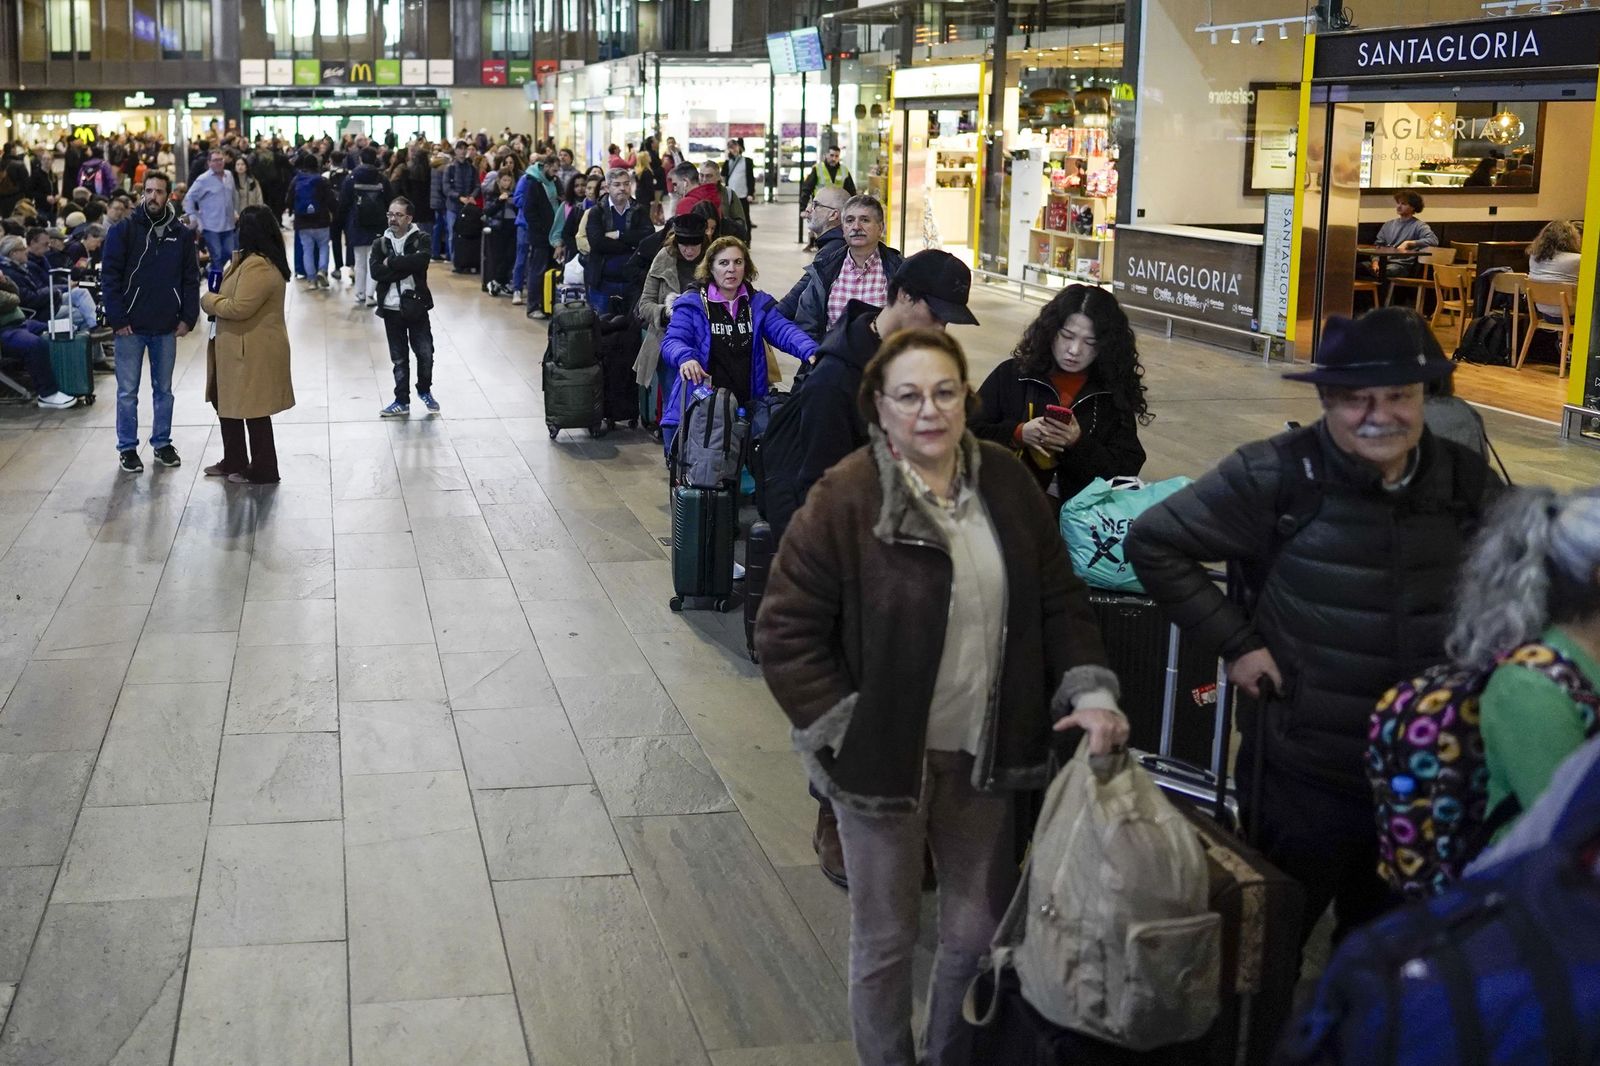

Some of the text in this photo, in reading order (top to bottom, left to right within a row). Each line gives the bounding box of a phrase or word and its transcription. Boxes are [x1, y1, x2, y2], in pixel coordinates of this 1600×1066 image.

[1358, 29, 1539, 67] SANTAGLORIA
[1372, 117, 1497, 140] AGLORIA
[1128, 256, 1239, 296] SANTAGLORIA
